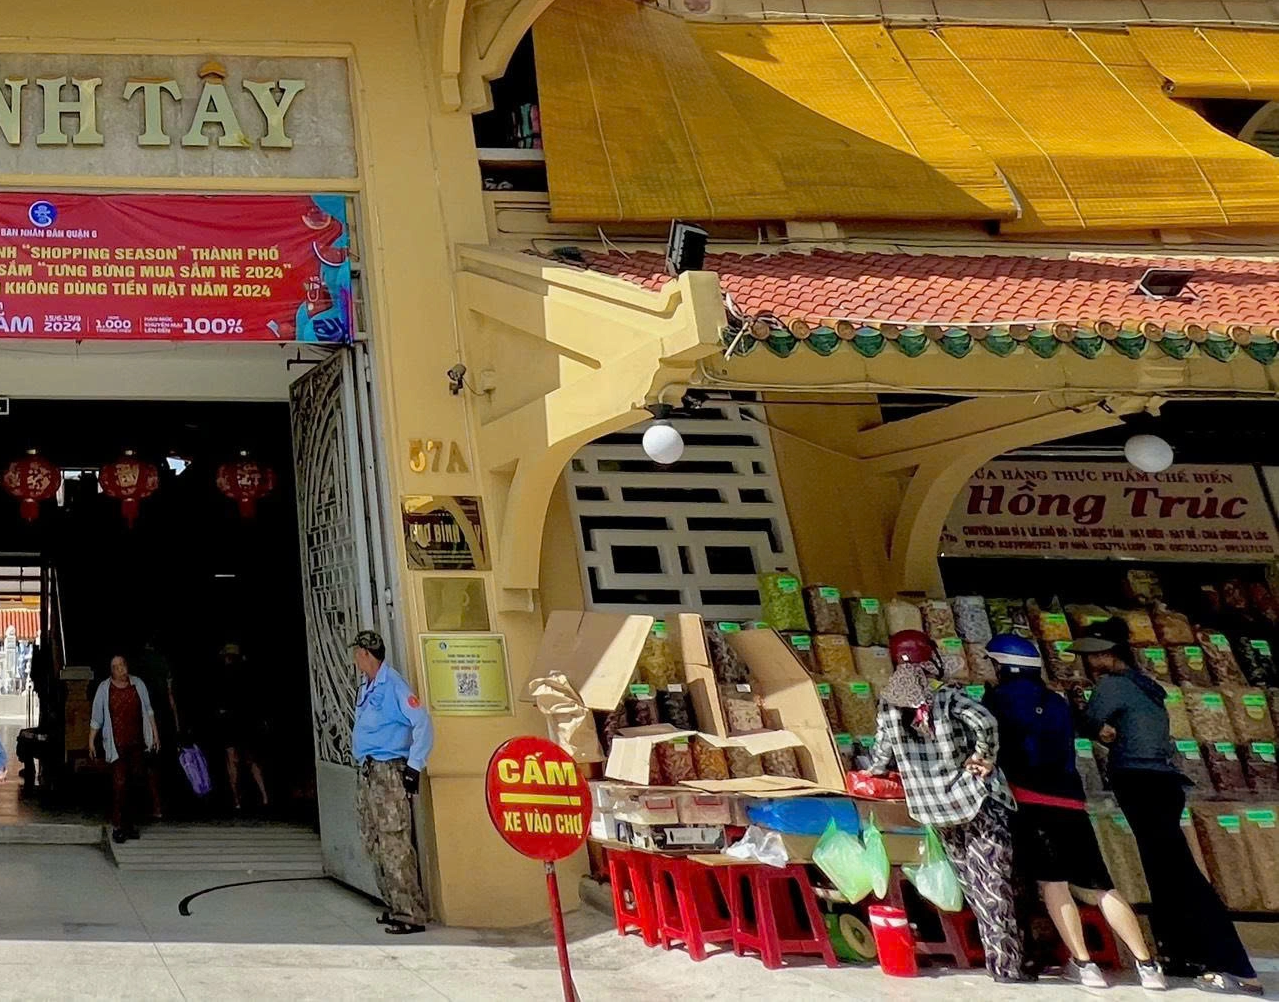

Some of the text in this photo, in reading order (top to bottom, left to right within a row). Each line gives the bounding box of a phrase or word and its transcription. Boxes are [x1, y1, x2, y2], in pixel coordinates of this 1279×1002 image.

[123, 61, 306, 149] TÂY
[1, 229, 18, 237] BAN
[66, 229, 89, 239] QUẬN
[191, 245, 243, 260] THÀNH
[247, 245, 280, 260] PHỐ
[92, 263, 135, 277] BỪNG
[140, 266, 175, 278] MUA
[179, 262, 215, 278] SẮM
[220, 263, 241, 278] HÈ
[5, 280, 59, 295] KHÔNG
[64, 280, 108, 295] DÙNG
[152, 282, 186, 298] MẶT
[191, 282, 228, 297] NĂM
[233, 284, 271, 297] 2024
[44, 321, 82, 332] 2024
[183, 318, 243, 334] 100%
[968, 468, 997, 479] ỬA
[1002, 468, 1048, 480] HÀNG
[1053, 469, 1097, 482] THỰC
[1193, 470, 1233, 484] BIẾN
[967, 481, 1248, 524] Hồng Trúc
[497, 752, 578, 786] CẤM
[503, 809, 583, 839] XE VÀO CHỢ
